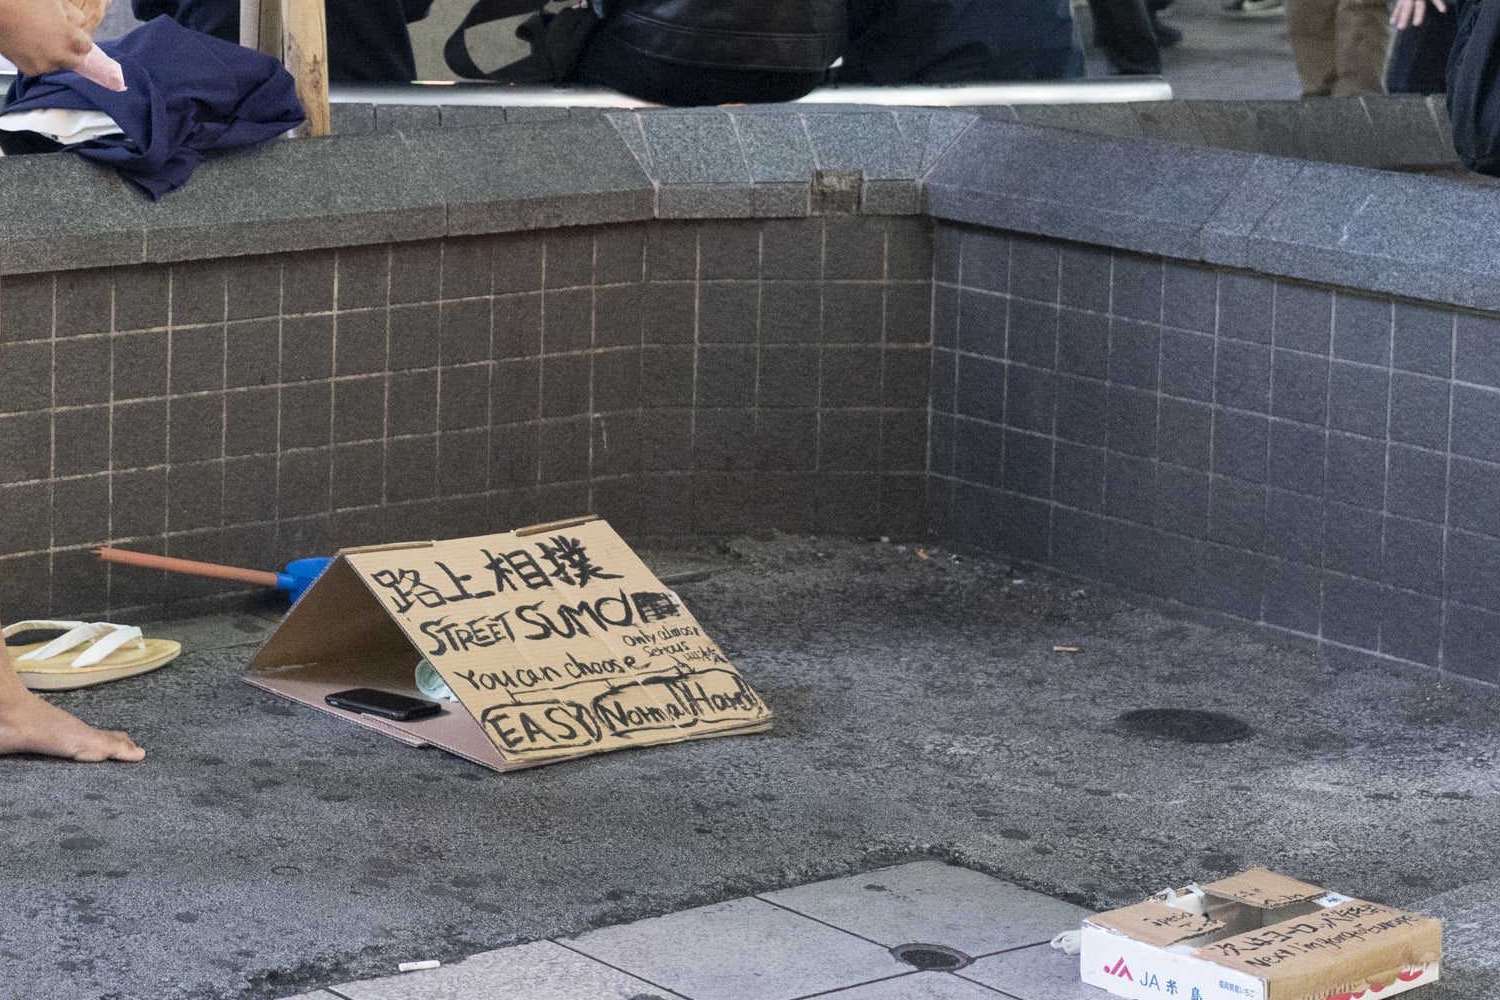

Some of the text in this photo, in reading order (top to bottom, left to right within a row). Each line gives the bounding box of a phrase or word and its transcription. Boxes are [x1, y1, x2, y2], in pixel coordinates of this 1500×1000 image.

[372, 535, 624, 614] 路上相撲
[419, 610, 516, 656] STREET
[514, 588, 633, 642] SUMO
[453, 652, 651, 692] You can choose
[488, 675, 757, 748] EASY Normal Hard
[1140, 971, 1160, 991] JA
[1244, 944, 1296, 969] Next
